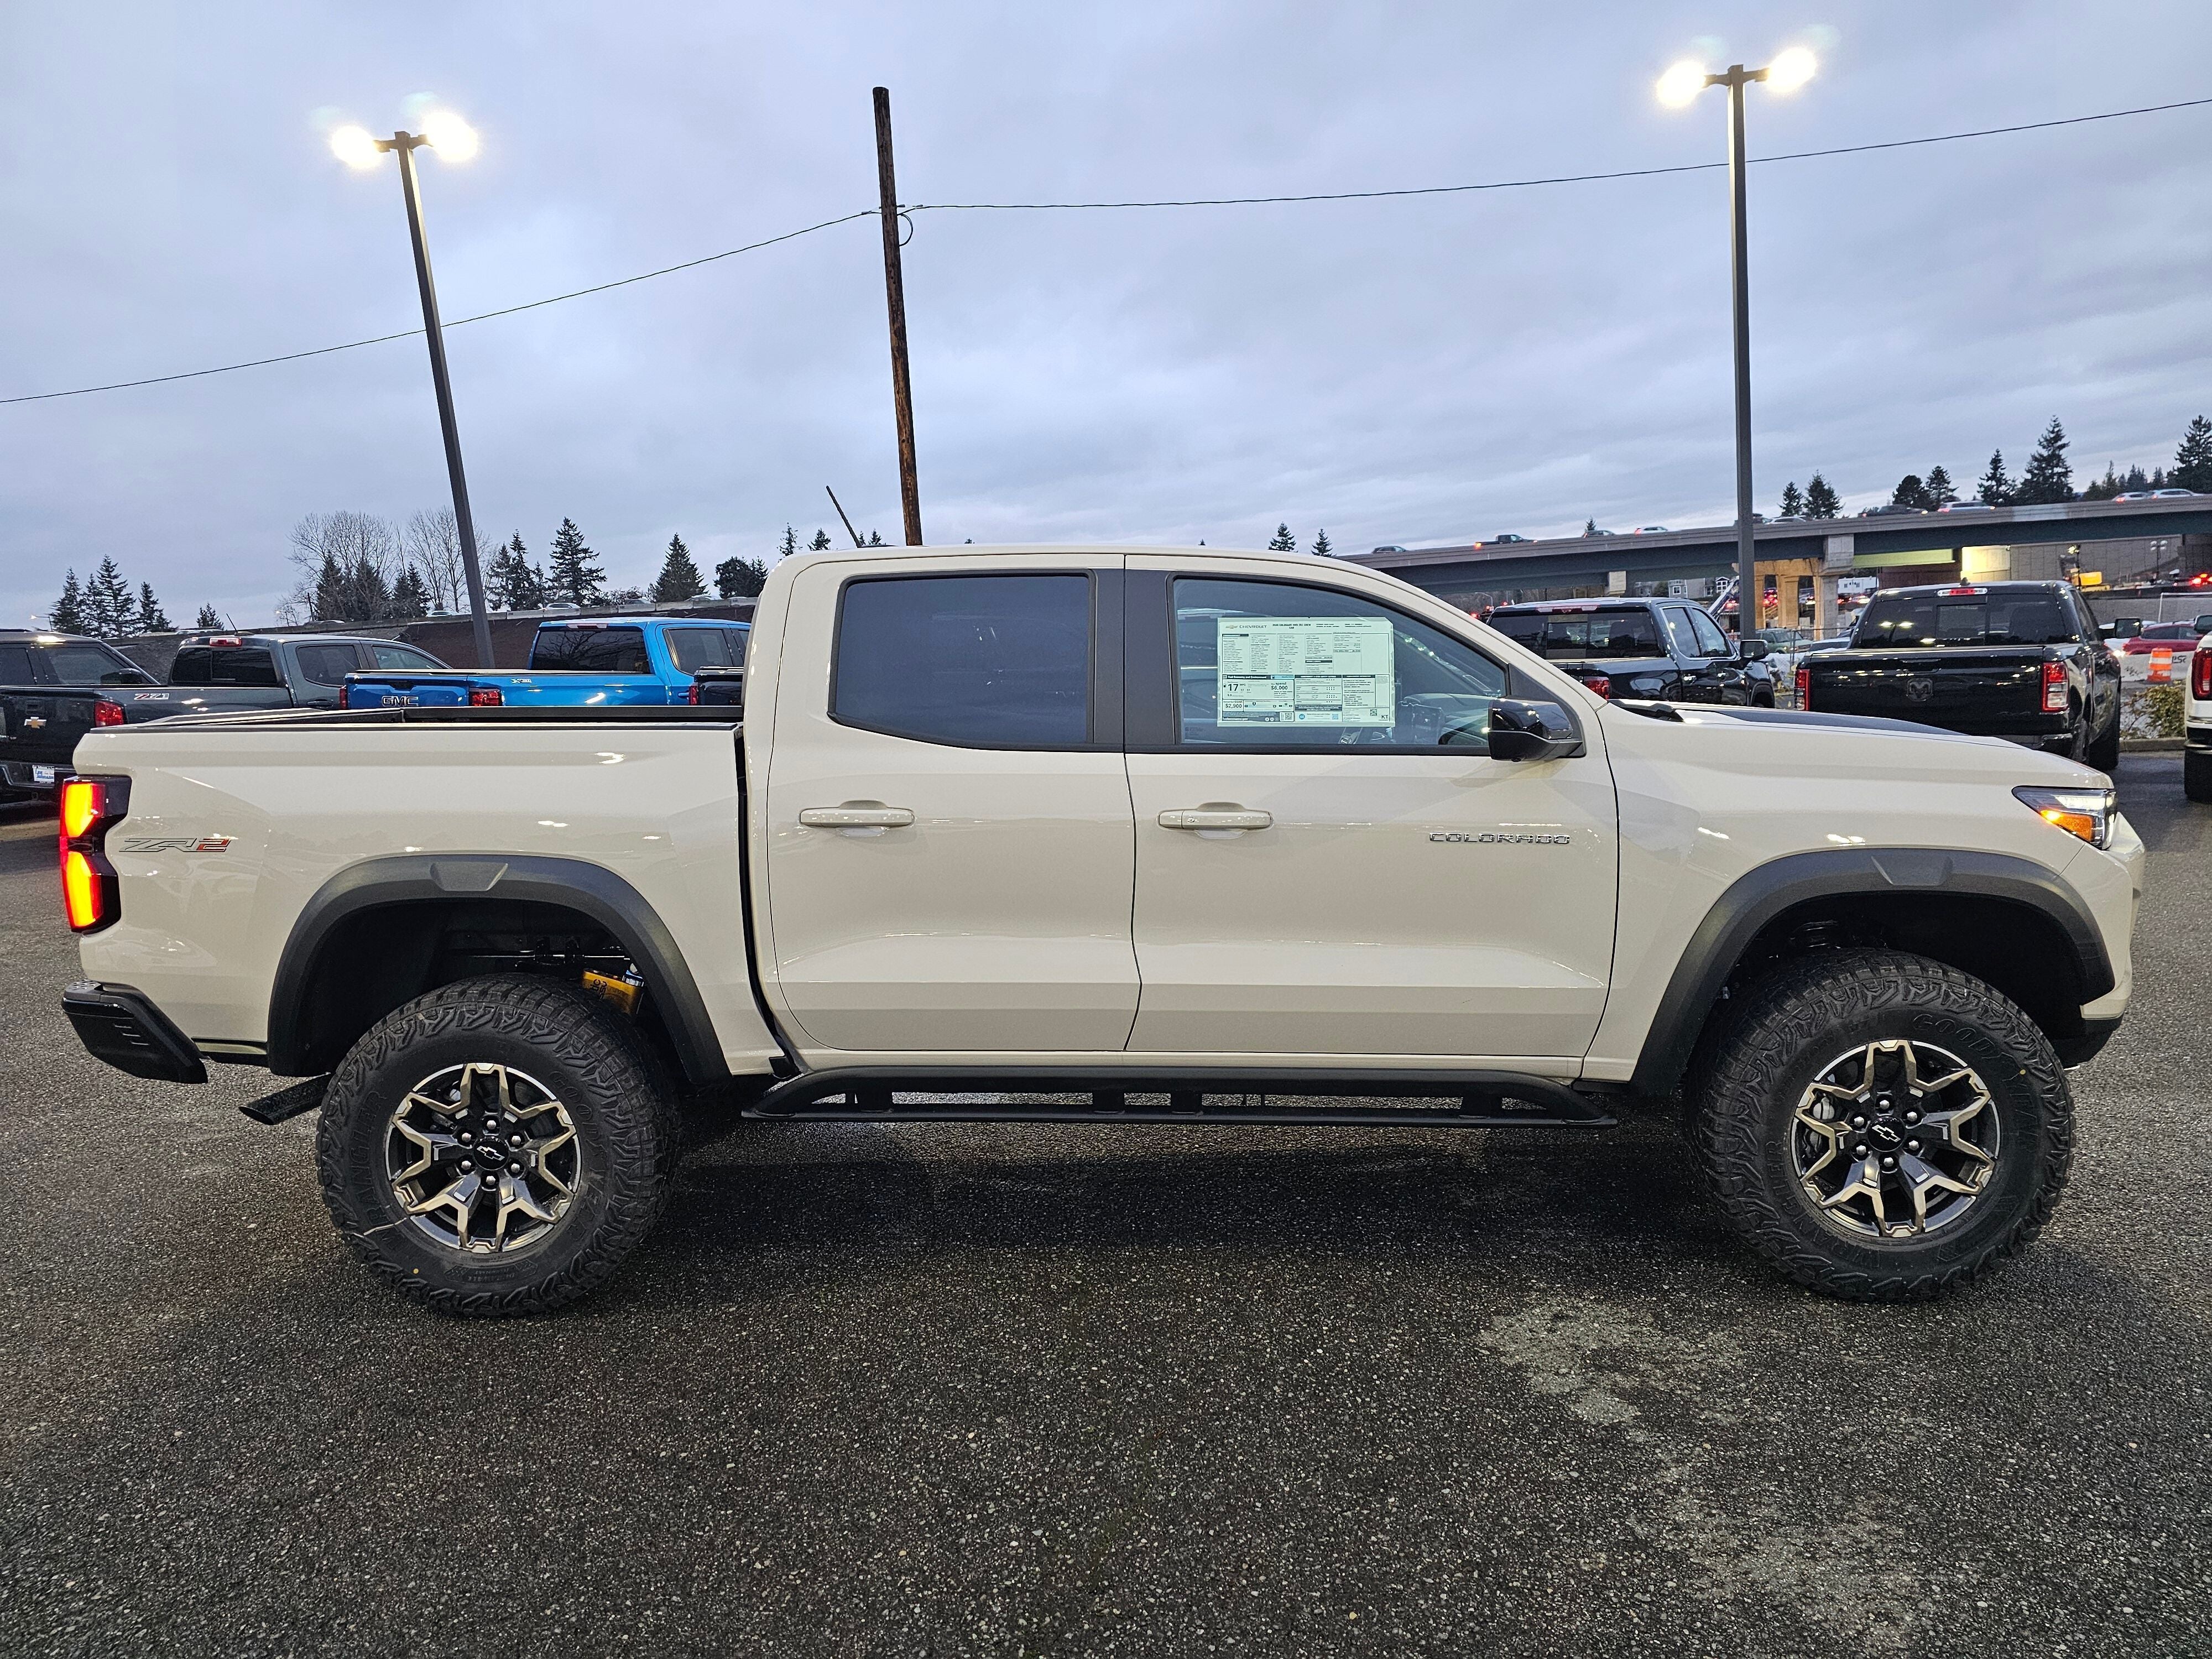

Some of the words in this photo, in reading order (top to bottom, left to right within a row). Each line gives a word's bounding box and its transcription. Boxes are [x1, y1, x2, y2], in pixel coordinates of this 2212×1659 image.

[382, 695, 419, 707] GMC
[1430, 832, 1570, 844] COLORADO
[118, 838, 231, 853] ZR2
